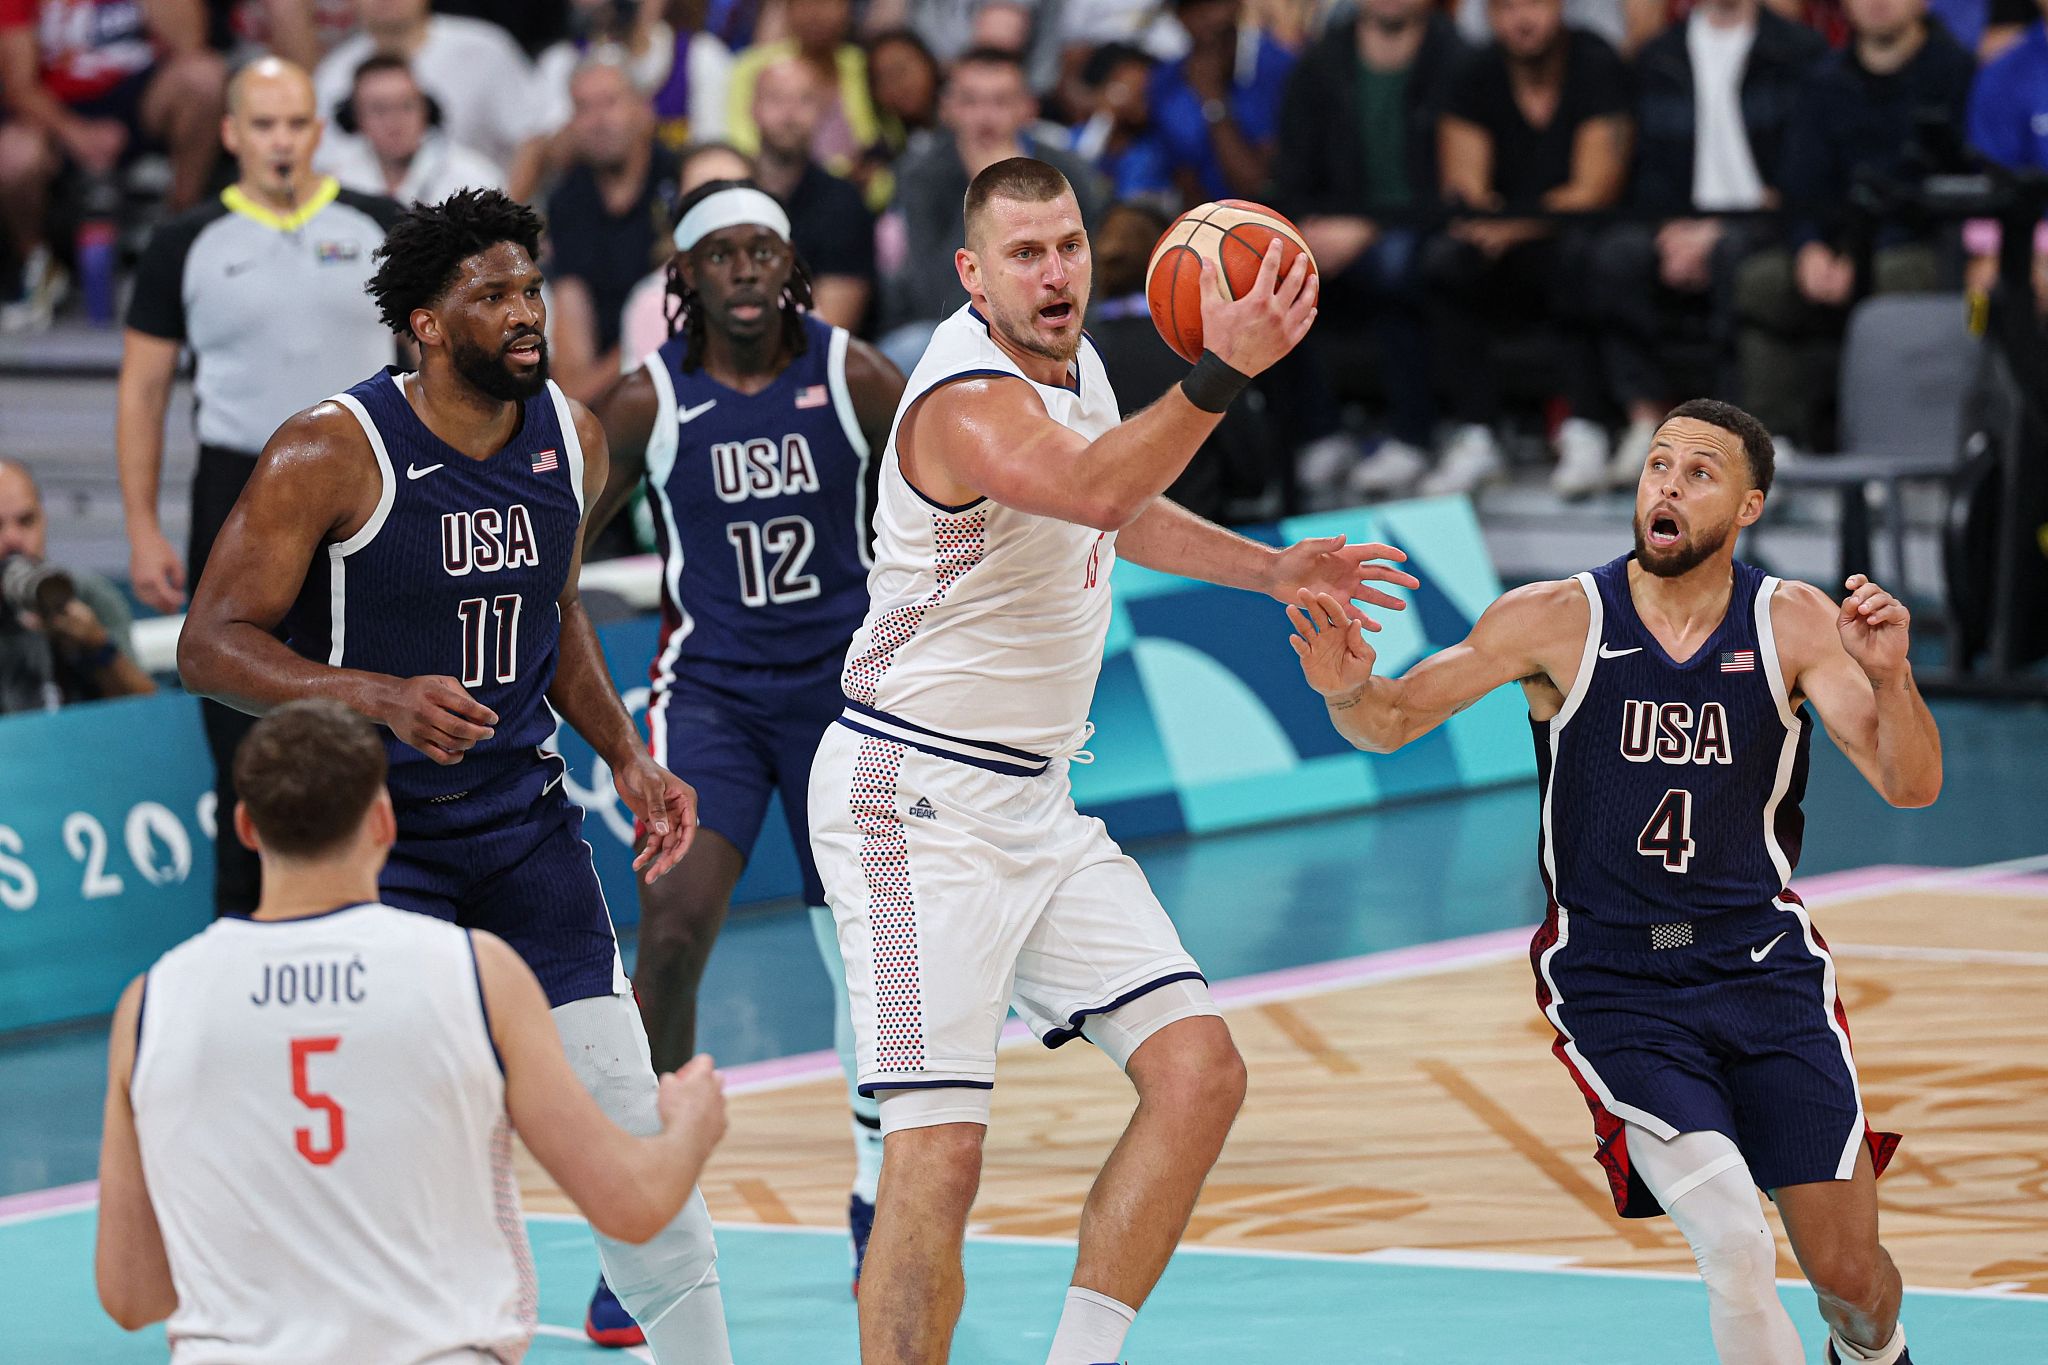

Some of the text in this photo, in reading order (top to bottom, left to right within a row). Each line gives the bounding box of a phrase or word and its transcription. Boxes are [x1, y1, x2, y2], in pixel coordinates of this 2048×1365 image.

[710, 433, 821, 504] USA
[441, 504, 539, 576] USA
[726, 515, 821, 607] 12
[457, 594, 523, 688] 11
[1620, 700, 1733, 765] USA
[909, 806, 938, 820] PEAK
[1637, 789, 1695, 874] 4
[289, 1034, 347, 1166] 5
